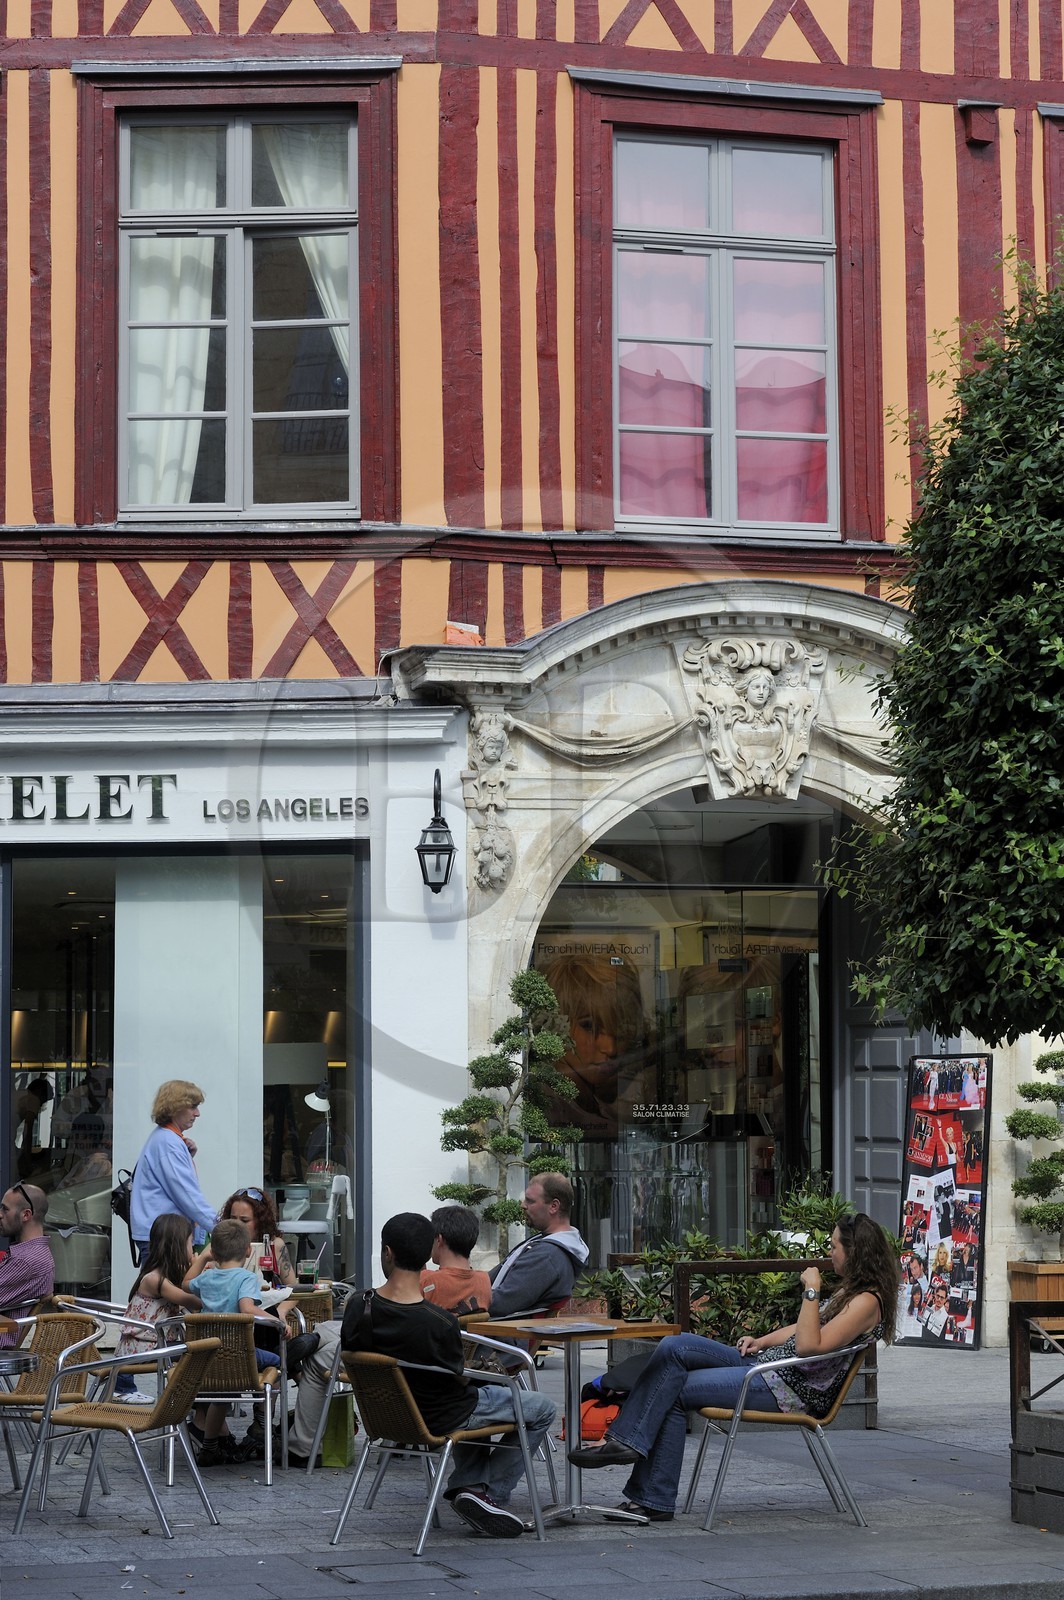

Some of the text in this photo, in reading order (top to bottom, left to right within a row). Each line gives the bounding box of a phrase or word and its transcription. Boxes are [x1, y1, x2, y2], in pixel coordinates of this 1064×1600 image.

[0, 773, 178, 821] ELET
[203, 797, 370, 819] LOS ANGELES
[537, 943, 572, 955] French
[574, 943, 617, 955] RIVIERA
